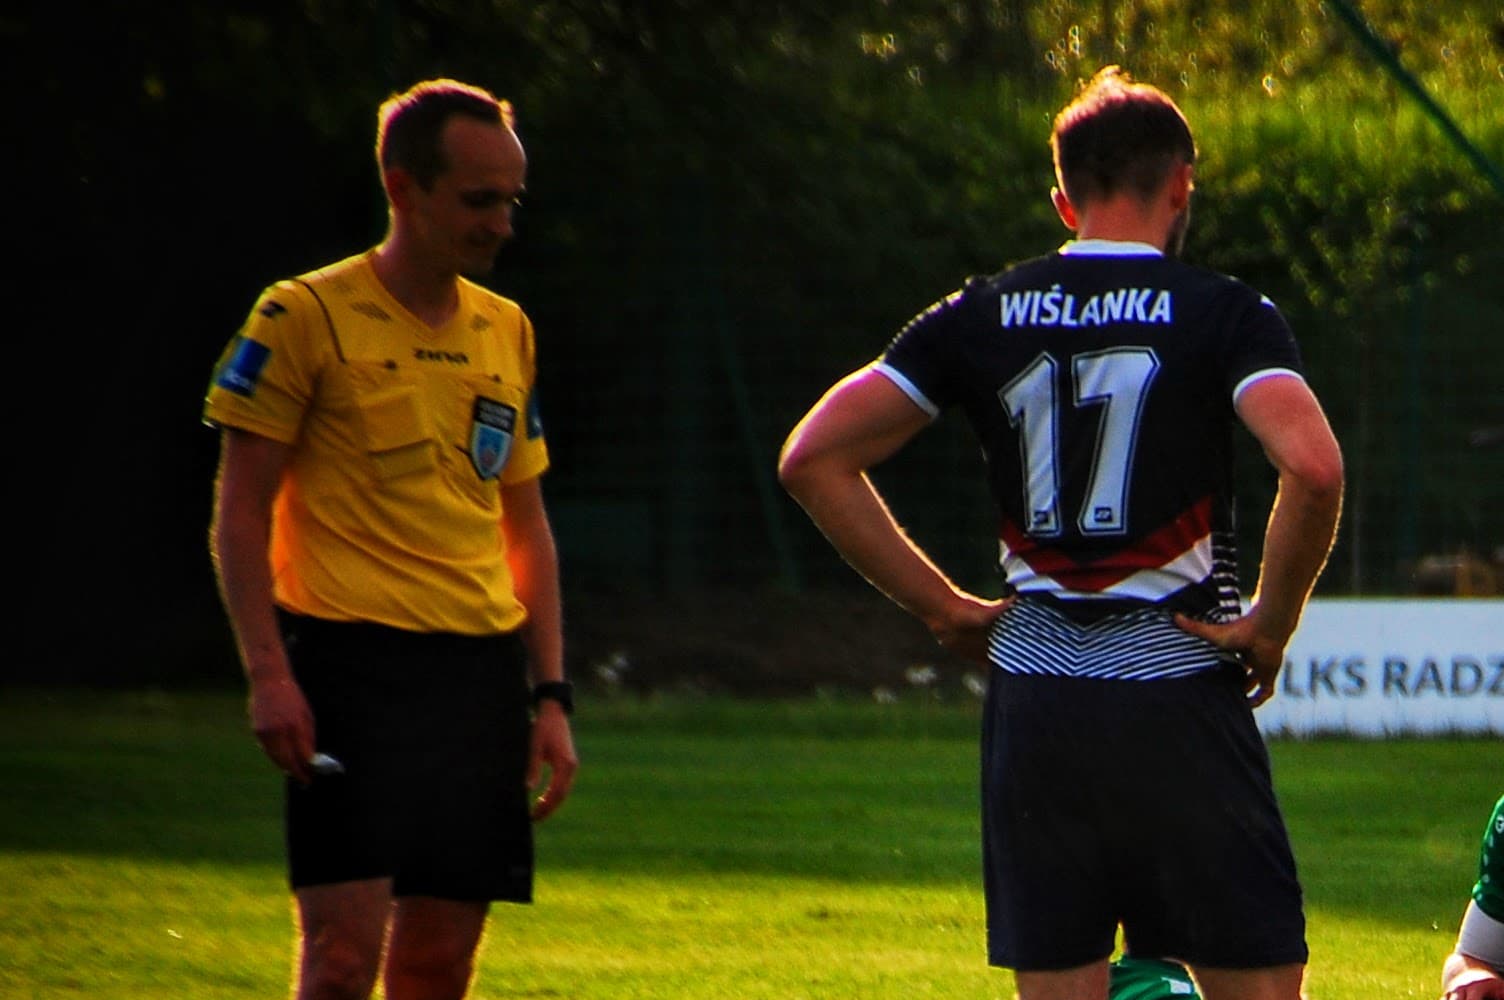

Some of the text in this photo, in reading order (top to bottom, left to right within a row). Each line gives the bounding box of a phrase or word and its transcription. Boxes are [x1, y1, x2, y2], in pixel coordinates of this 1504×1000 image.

[999, 284, 1174, 327] WIŚLANKA
[997, 345, 1161, 537] 17
[1282, 655, 1368, 699] LKS
